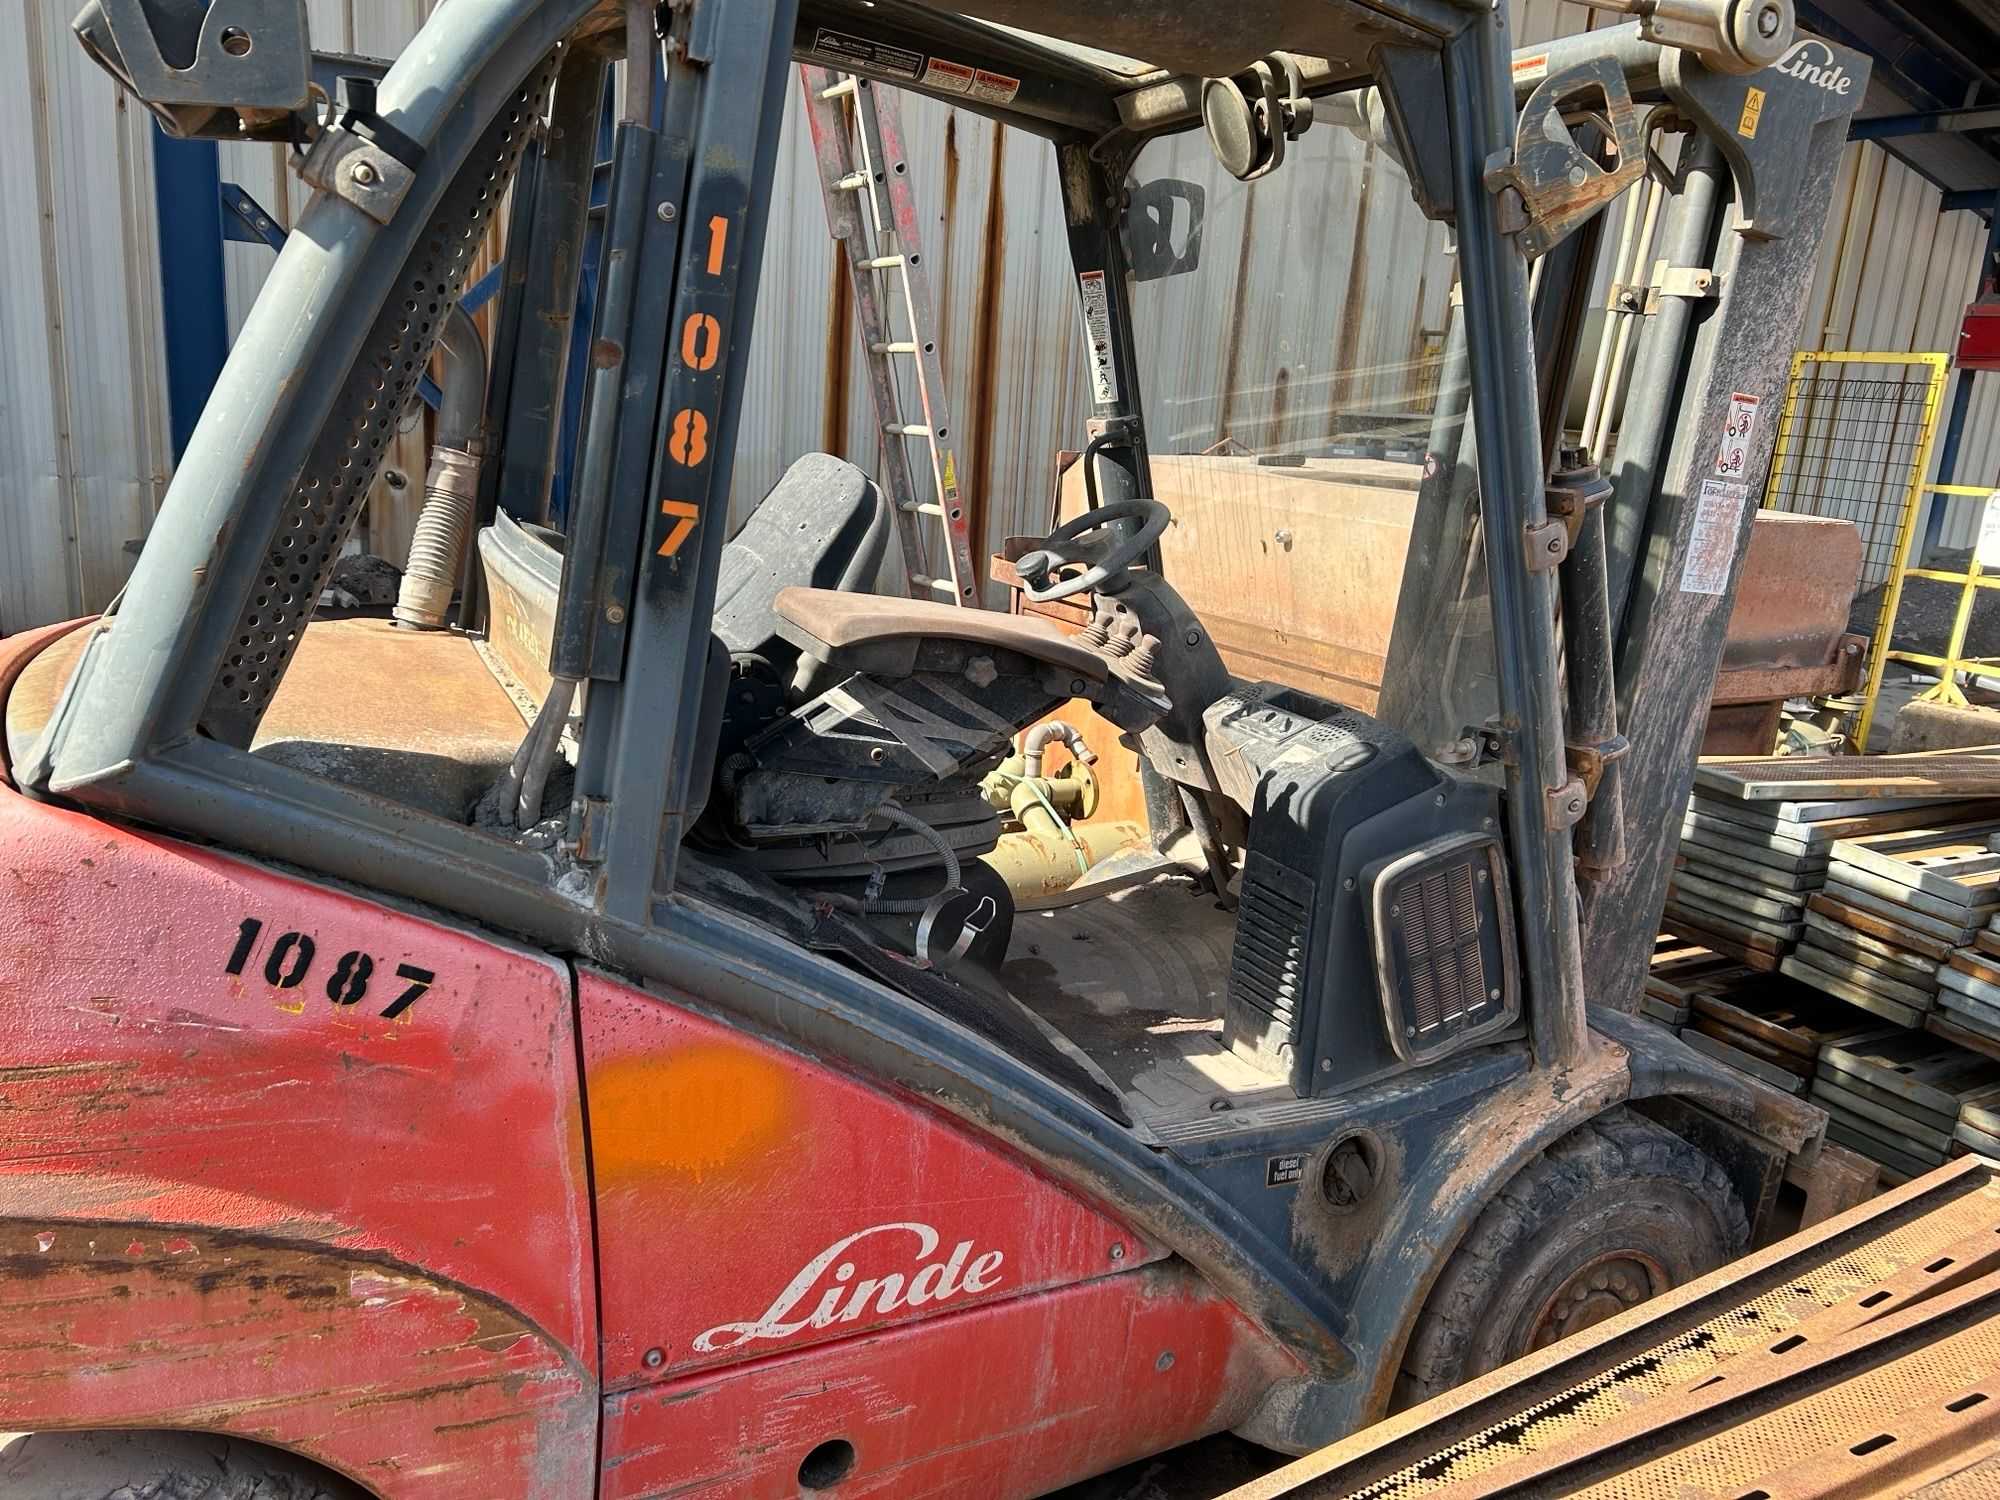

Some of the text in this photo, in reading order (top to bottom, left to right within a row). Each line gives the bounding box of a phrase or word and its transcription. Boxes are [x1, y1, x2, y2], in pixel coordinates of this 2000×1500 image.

[1767, 39, 1851, 95] Linde
[657, 215, 729, 557] 1087
[225, 917, 436, 1019] 1087
[1274, 1168, 1303, 1182] fuel only
[1280, 1158, 1299, 1170] diesel
[692, 1221, 1004, 1352] Linde
